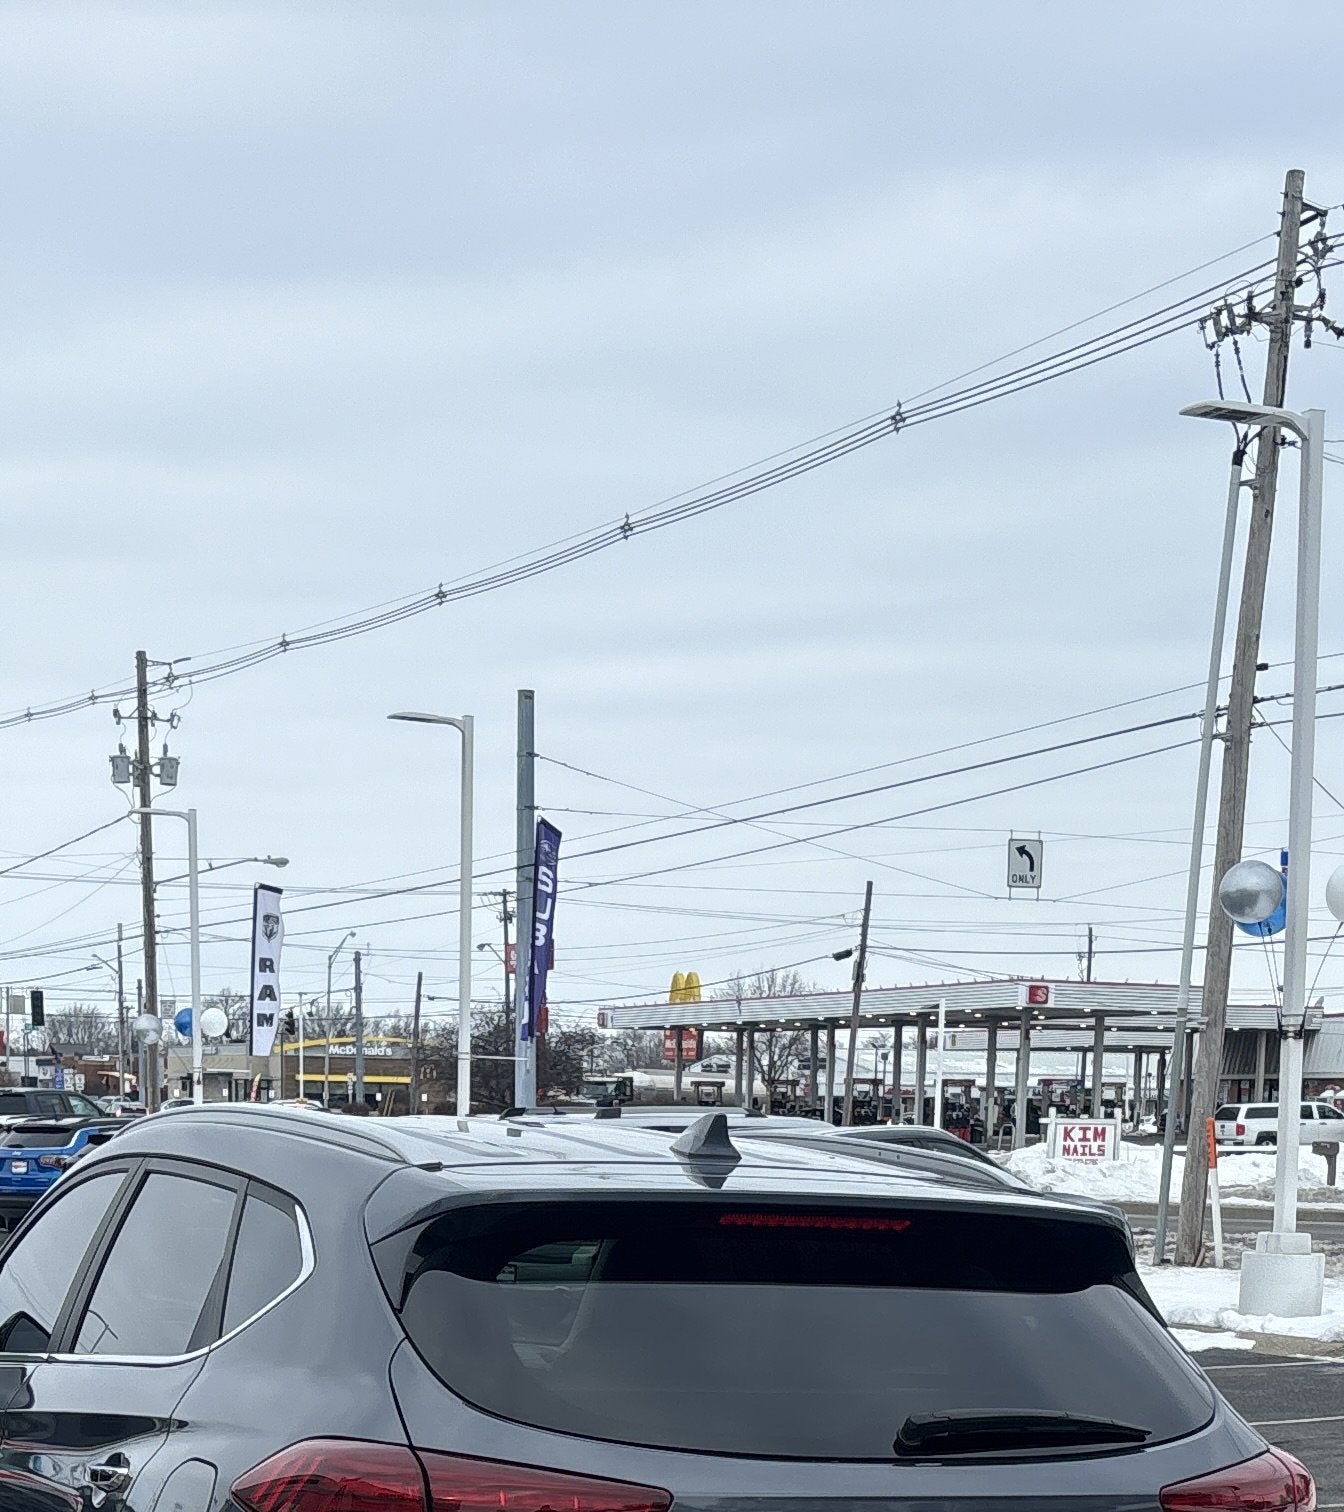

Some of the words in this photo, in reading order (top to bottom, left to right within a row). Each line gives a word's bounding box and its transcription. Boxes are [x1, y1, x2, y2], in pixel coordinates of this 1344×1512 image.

[1011, 873, 1037, 884] ONLY
[257, 957, 277, 1028] RAM
[328, 1044, 393, 1056] McDnald's
[1063, 1126, 1107, 1142] KIM
[1062, 1144, 1106, 1156] NAILS
